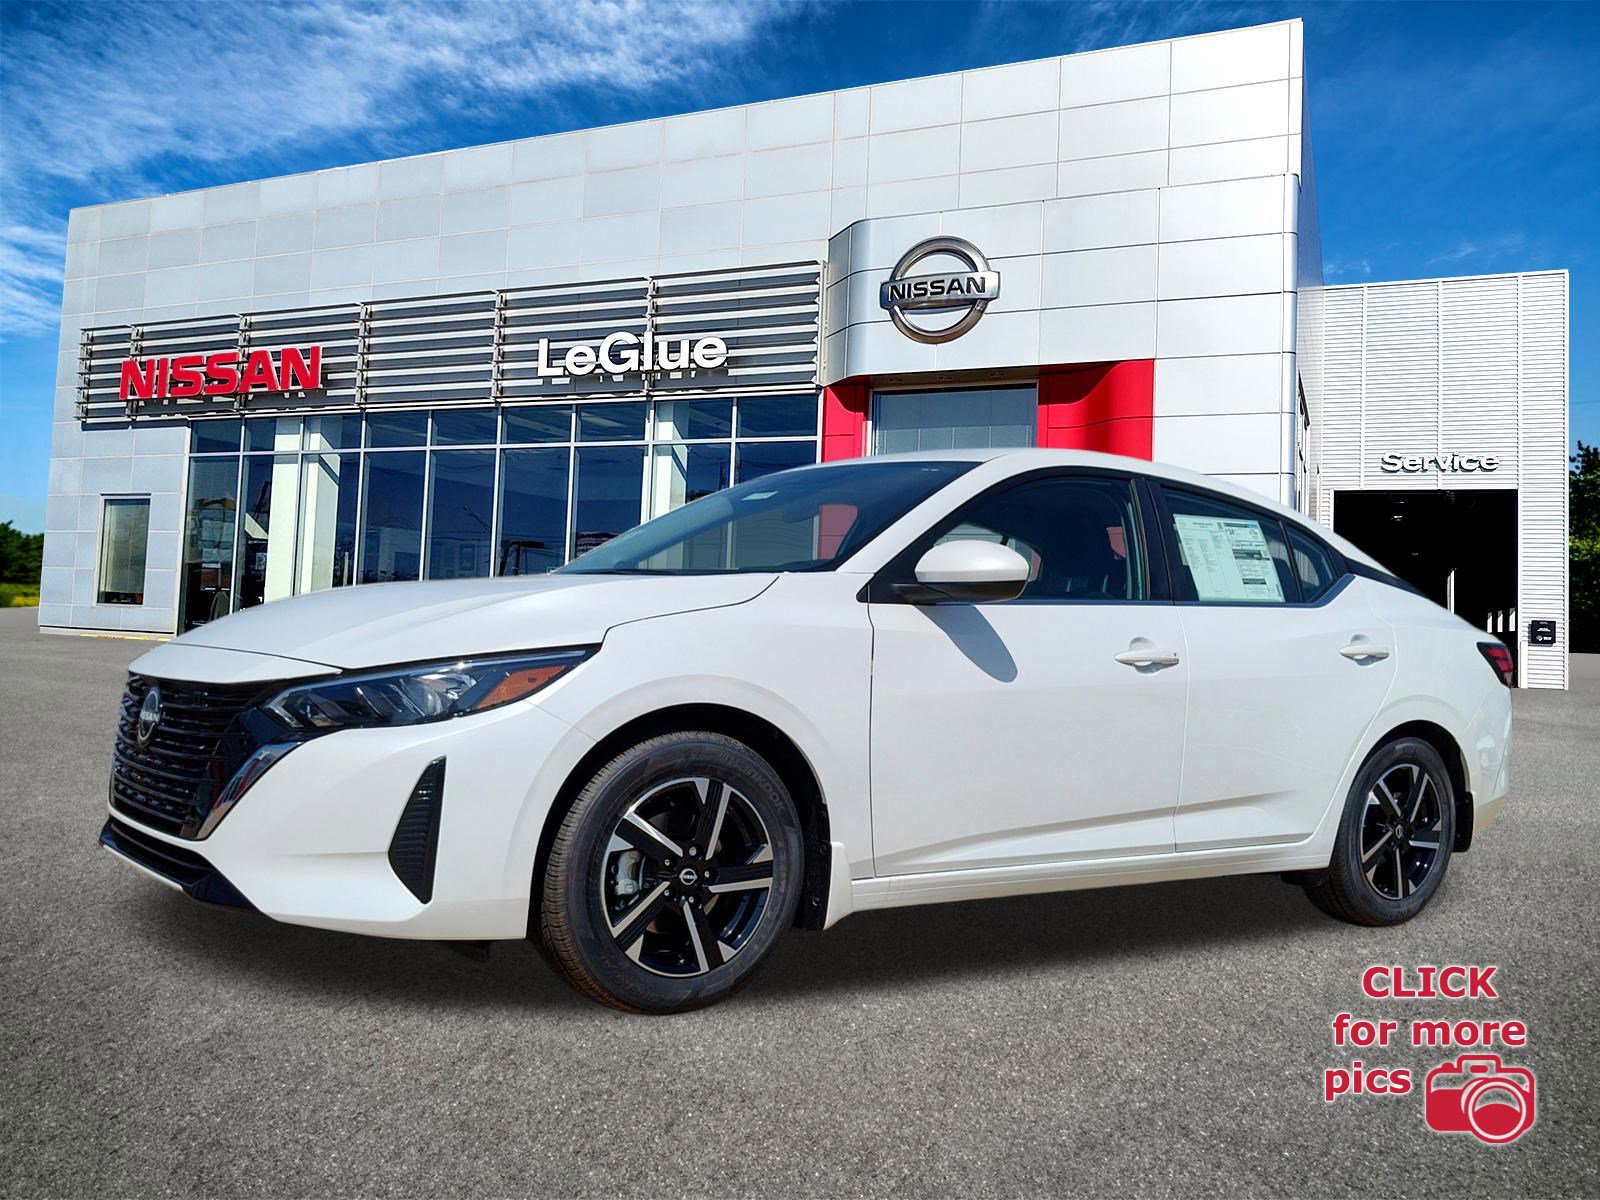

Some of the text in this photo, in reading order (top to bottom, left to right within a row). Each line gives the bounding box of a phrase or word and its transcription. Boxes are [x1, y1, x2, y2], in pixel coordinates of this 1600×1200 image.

[888, 276, 986, 301] NISSAN
[537, 331, 728, 377] LeGlue
[119, 345, 322, 401] NISSAN
[1381, 451, 1500, 473] Service
